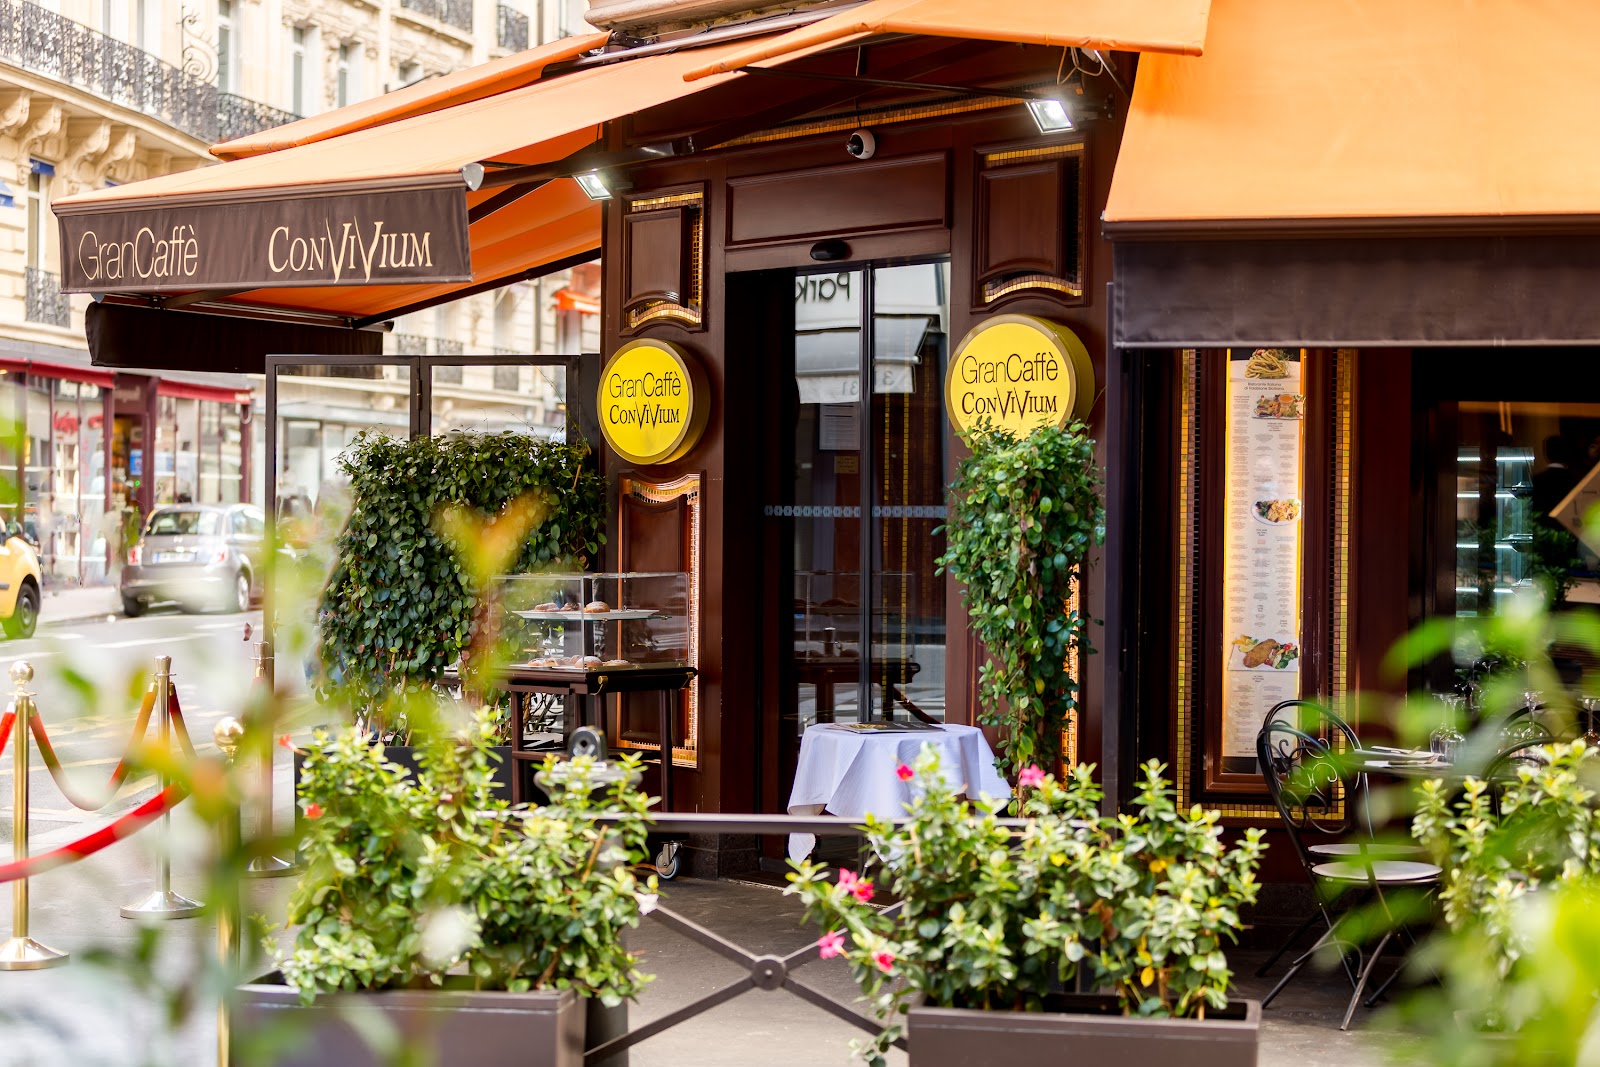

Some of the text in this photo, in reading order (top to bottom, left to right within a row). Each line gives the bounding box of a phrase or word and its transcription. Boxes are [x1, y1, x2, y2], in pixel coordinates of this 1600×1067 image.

[78, 224, 198, 280] GranCaffè
[609, 371, 681, 398] GranCaffè
[961, 352, 1058, 385] GranCaffè
